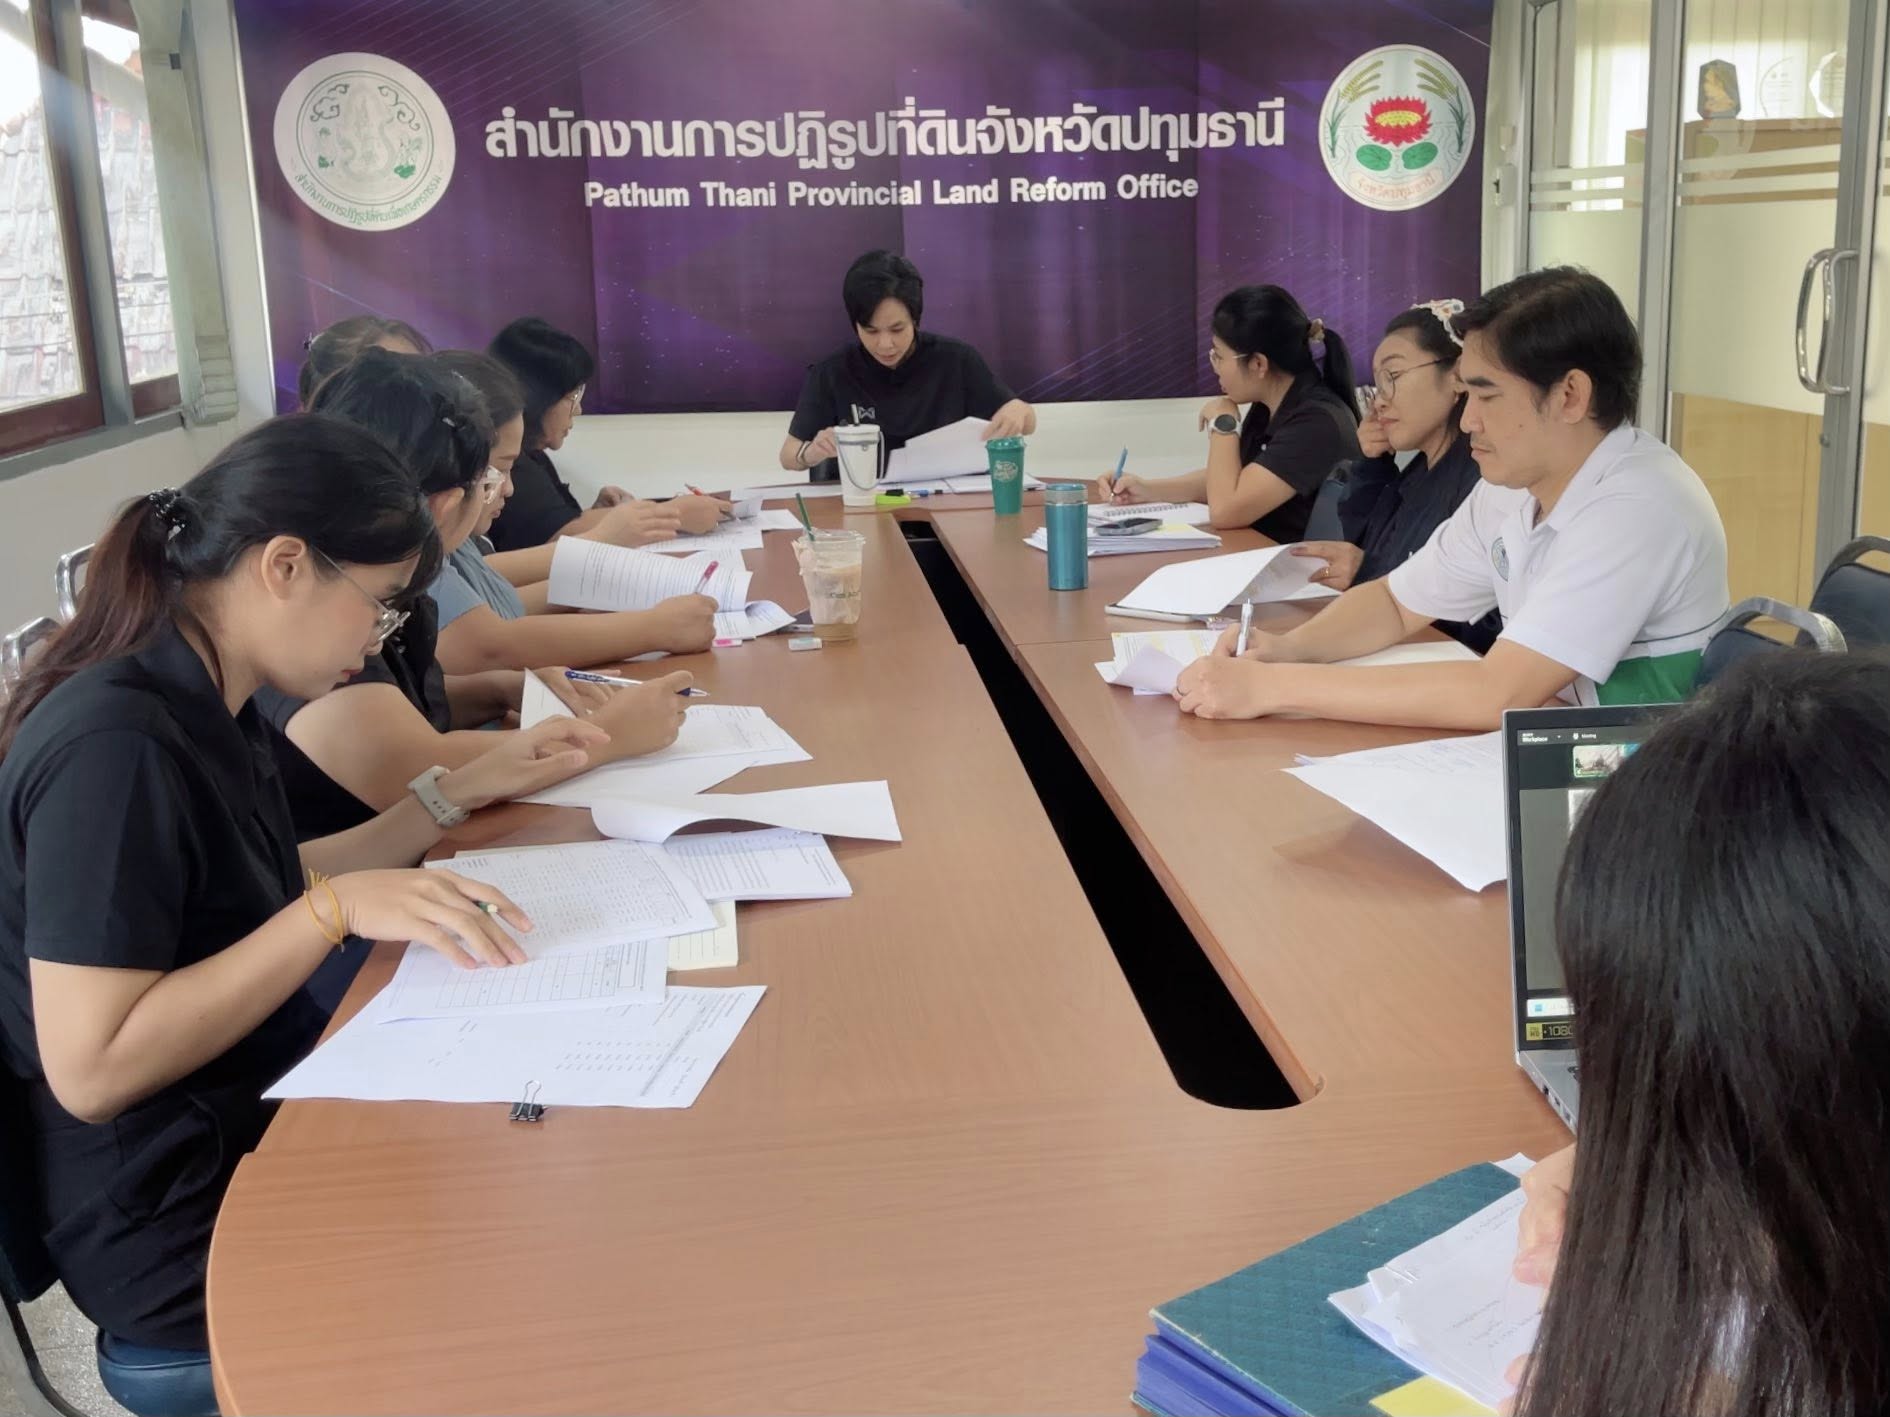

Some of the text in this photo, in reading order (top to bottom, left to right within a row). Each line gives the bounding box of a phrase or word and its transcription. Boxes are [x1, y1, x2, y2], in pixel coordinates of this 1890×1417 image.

[485, 96, 1285, 170] สำนักงานการปฏิรูปที่ดินจังหวัดปทุมธานี
[584, 174, 1199, 207] Pathum Thani Provincial Land Reform Office
